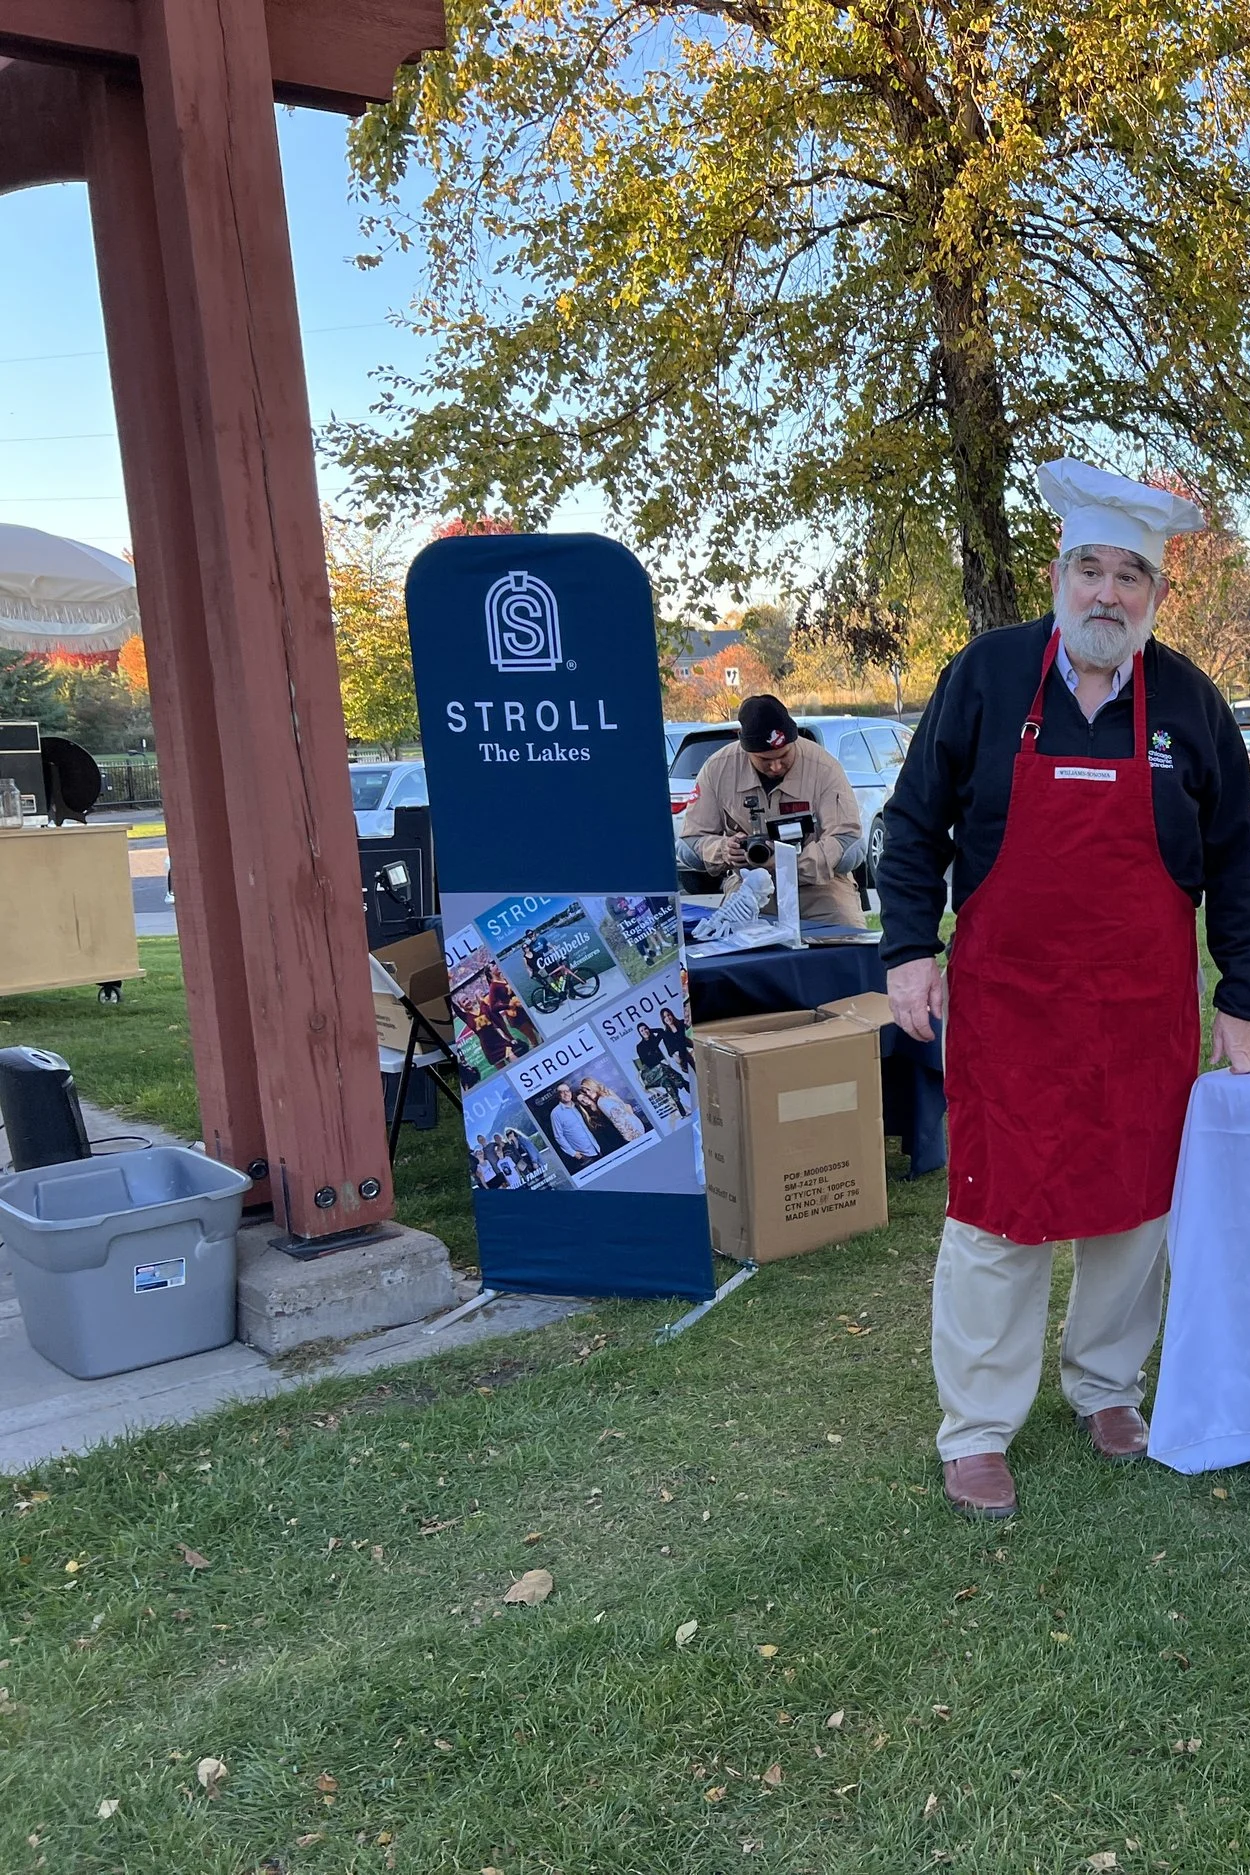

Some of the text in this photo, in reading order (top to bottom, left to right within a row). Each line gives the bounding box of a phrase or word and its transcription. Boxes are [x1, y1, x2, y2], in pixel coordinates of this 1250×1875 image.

[446, 700, 618, 733] STROLL
[479, 743, 591, 762] The Lakes
[617, 918, 636, 930] The
[627, 927, 656, 947] Family
[537, 932, 590, 969] Campbells
[602, 984, 679, 1036] STROLL
[520, 1038, 593, 1088] STROLL
[828, 1180, 856, 1191] 100PCS
[785, 1202, 802, 1211] CTN
[834, 1192, 844, 1200] OF
[786, 1210, 809, 1222] MADE
[811, 1208, 819, 1216] IN
[821, 1199, 857, 1213] VIETNAM
